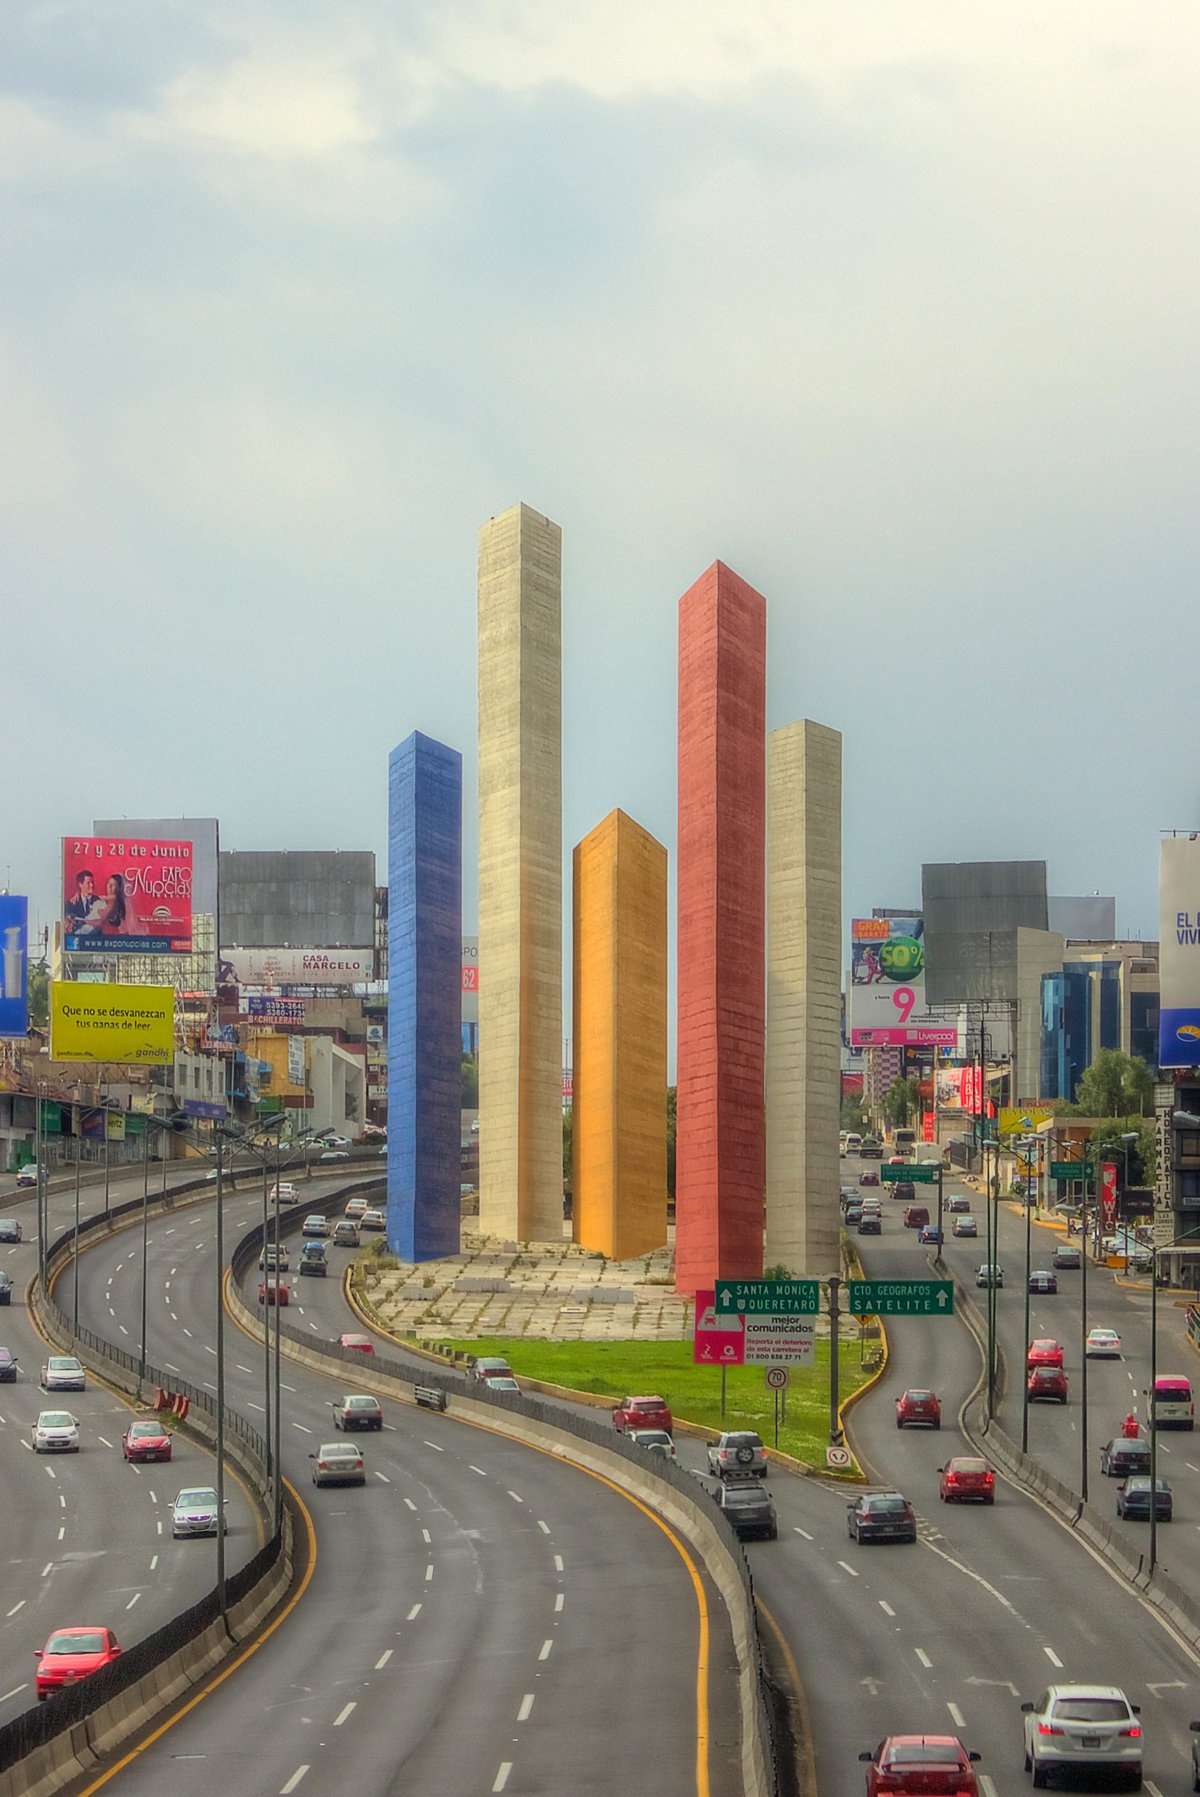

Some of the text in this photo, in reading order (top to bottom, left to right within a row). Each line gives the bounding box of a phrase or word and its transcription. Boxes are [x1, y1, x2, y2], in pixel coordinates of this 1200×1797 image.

[74, 842, 190, 858] 27 y 28 de Junio
[162, 866, 192, 882] EXPO
[124, 866, 191, 897] Nupcias
[1176, 912, 1193, 928] EL
[858, 922, 888, 931] GRAN
[1176, 929, 1200, 945] VIV
[303, 962, 360, 970] MARCELO
[893, 987, 915, 1023] 9
[62, 1005, 165, 1019] Que no se desvanezcan
[76, 1020, 91, 1028] tus
[121, 1021, 133, 1029] de
[918, 1031, 954, 1042] Liverpool
[135, 1047, 169, 1057] gandhi
[1155, 1115, 1163, 1206] FARMACIA
[736, 1285, 815, 1296] SANTA MONICA
[877, 1285, 931, 1296] GEOGRAFOS
[748, 1299, 816, 1310] QUERETARO
[854, 1300, 931, 1311] SATELITE
[771, 1315, 800, 1326] mejor
[746, 1324, 814, 1333] comunicados
[746, 1338, 773, 1346] Reporta
[772, 1372, 782, 1381] 70
